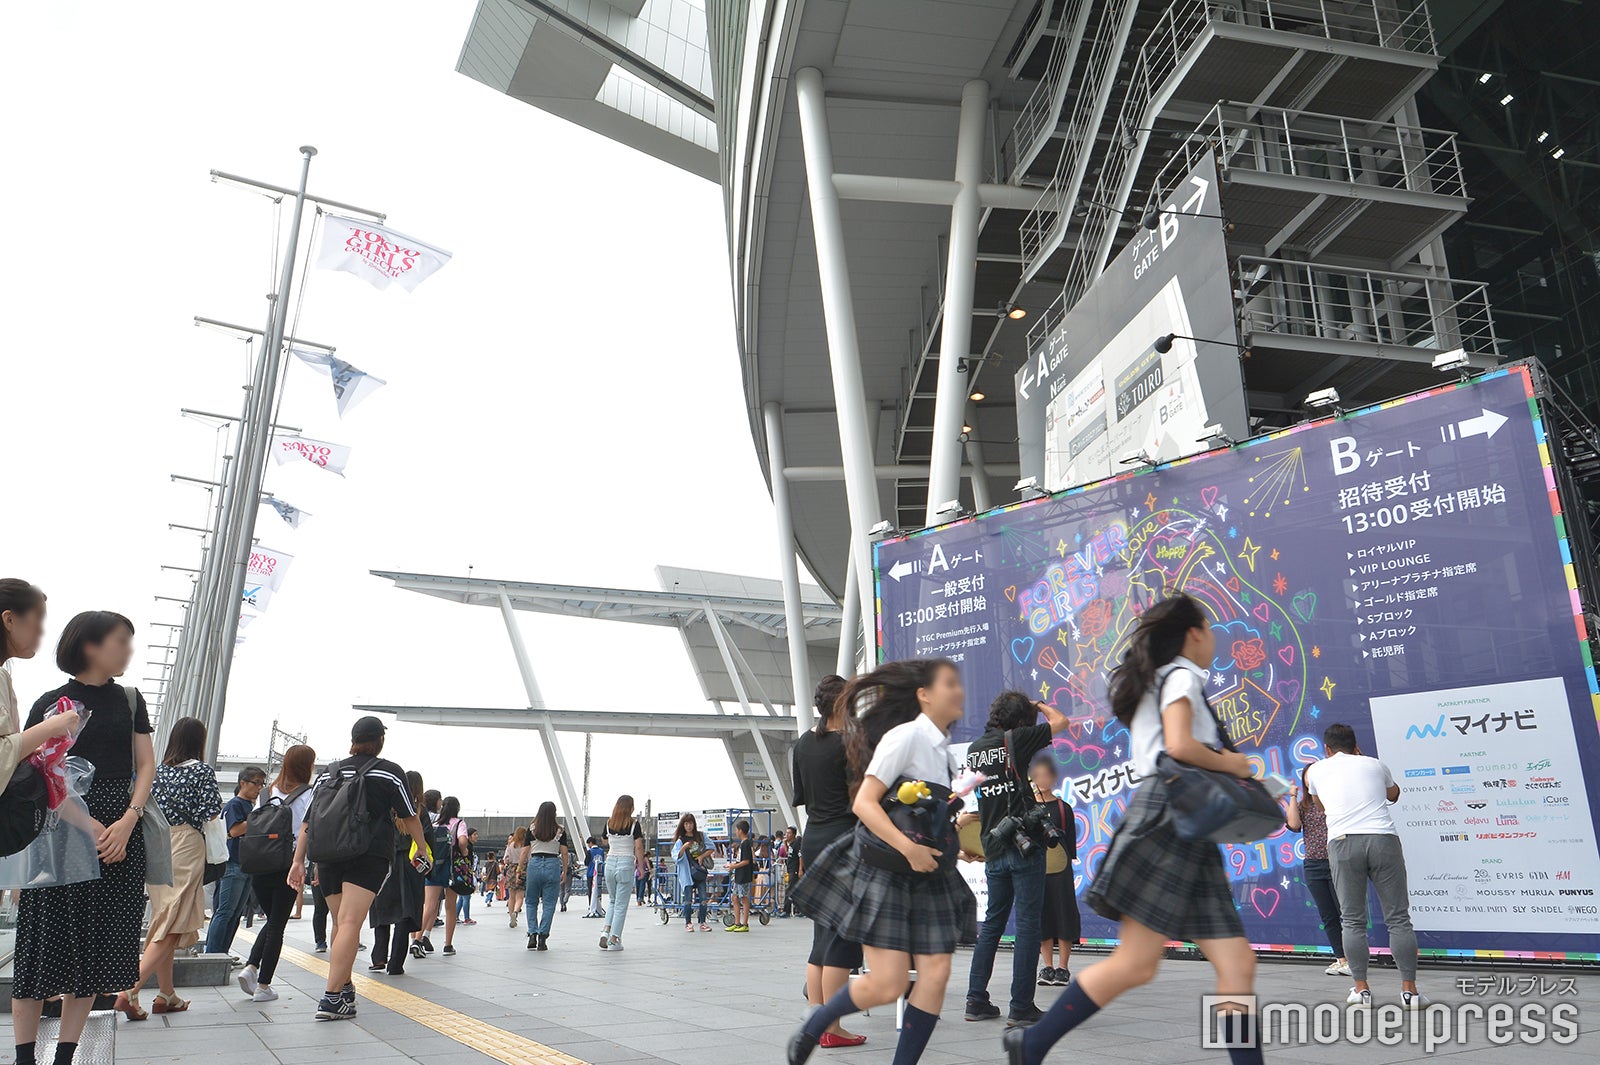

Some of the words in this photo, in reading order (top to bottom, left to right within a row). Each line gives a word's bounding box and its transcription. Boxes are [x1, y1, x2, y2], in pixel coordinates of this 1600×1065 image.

[1159, 203, 1179, 251] B
[346, 237, 415, 272] GIRLS
[350, 228, 421, 256] TOKYO
[1133, 229, 1157, 261] ゲート
[1134, 245, 1159, 280] GATE
[1049, 328, 1067, 355] ゲート
[1036, 351, 1049, 387] A
[1050, 344, 1069, 371] GATE
[1050, 380, 1057, 399] N
[1131, 367, 1162, 405] TOIRO
[1159, 405, 1169, 425] B
[1330, 436, 1361, 476] B
[1365, 441, 1421, 467] ゲート
[1338, 470, 1431, 510] 招待受付
[1118, 521, 1159, 569] Love
[1155, 544, 1187, 560] Happy
[1357, 539, 1416, 558] ロイヤルVIP
[927, 543, 950, 575] A
[950, 549, 983, 569] ゲート
[1018, 524, 1124, 618] FOREVER
[1359, 563, 1379, 574] VIP
[1381, 553, 1431, 571] LOUNGE
[931, 573, 985, 598] 一般受付
[1361, 562, 1477, 591] アリーナプラチナ指定席
[1029, 573, 1097, 634] GIRLS
[1364, 586, 1438, 607] ゴールド指定席
[1367, 608, 1413, 624] Sブロック
[921, 634, 935, 643] TGC
[922, 636, 987, 655] アリーナプラチナ指定席
[1369, 625, 1416, 641] Aブロック
[1371, 644, 1405, 658] 託児所
[1217, 692, 1250, 721] IRLS
[1450, 709, 1537, 735] マイナビ
[1402, 785, 1445, 793] OWNDAYS
[1543, 795, 1569, 804] iCure
[1440, 834, 1469, 842] DOUTOR
[1412, 905, 1461, 913] REDYAZEL
[1512, 905, 1527, 914] SLY
[1531, 906, 1563, 914] SNIDEL
[1575, 905, 1598, 914] WEGO
